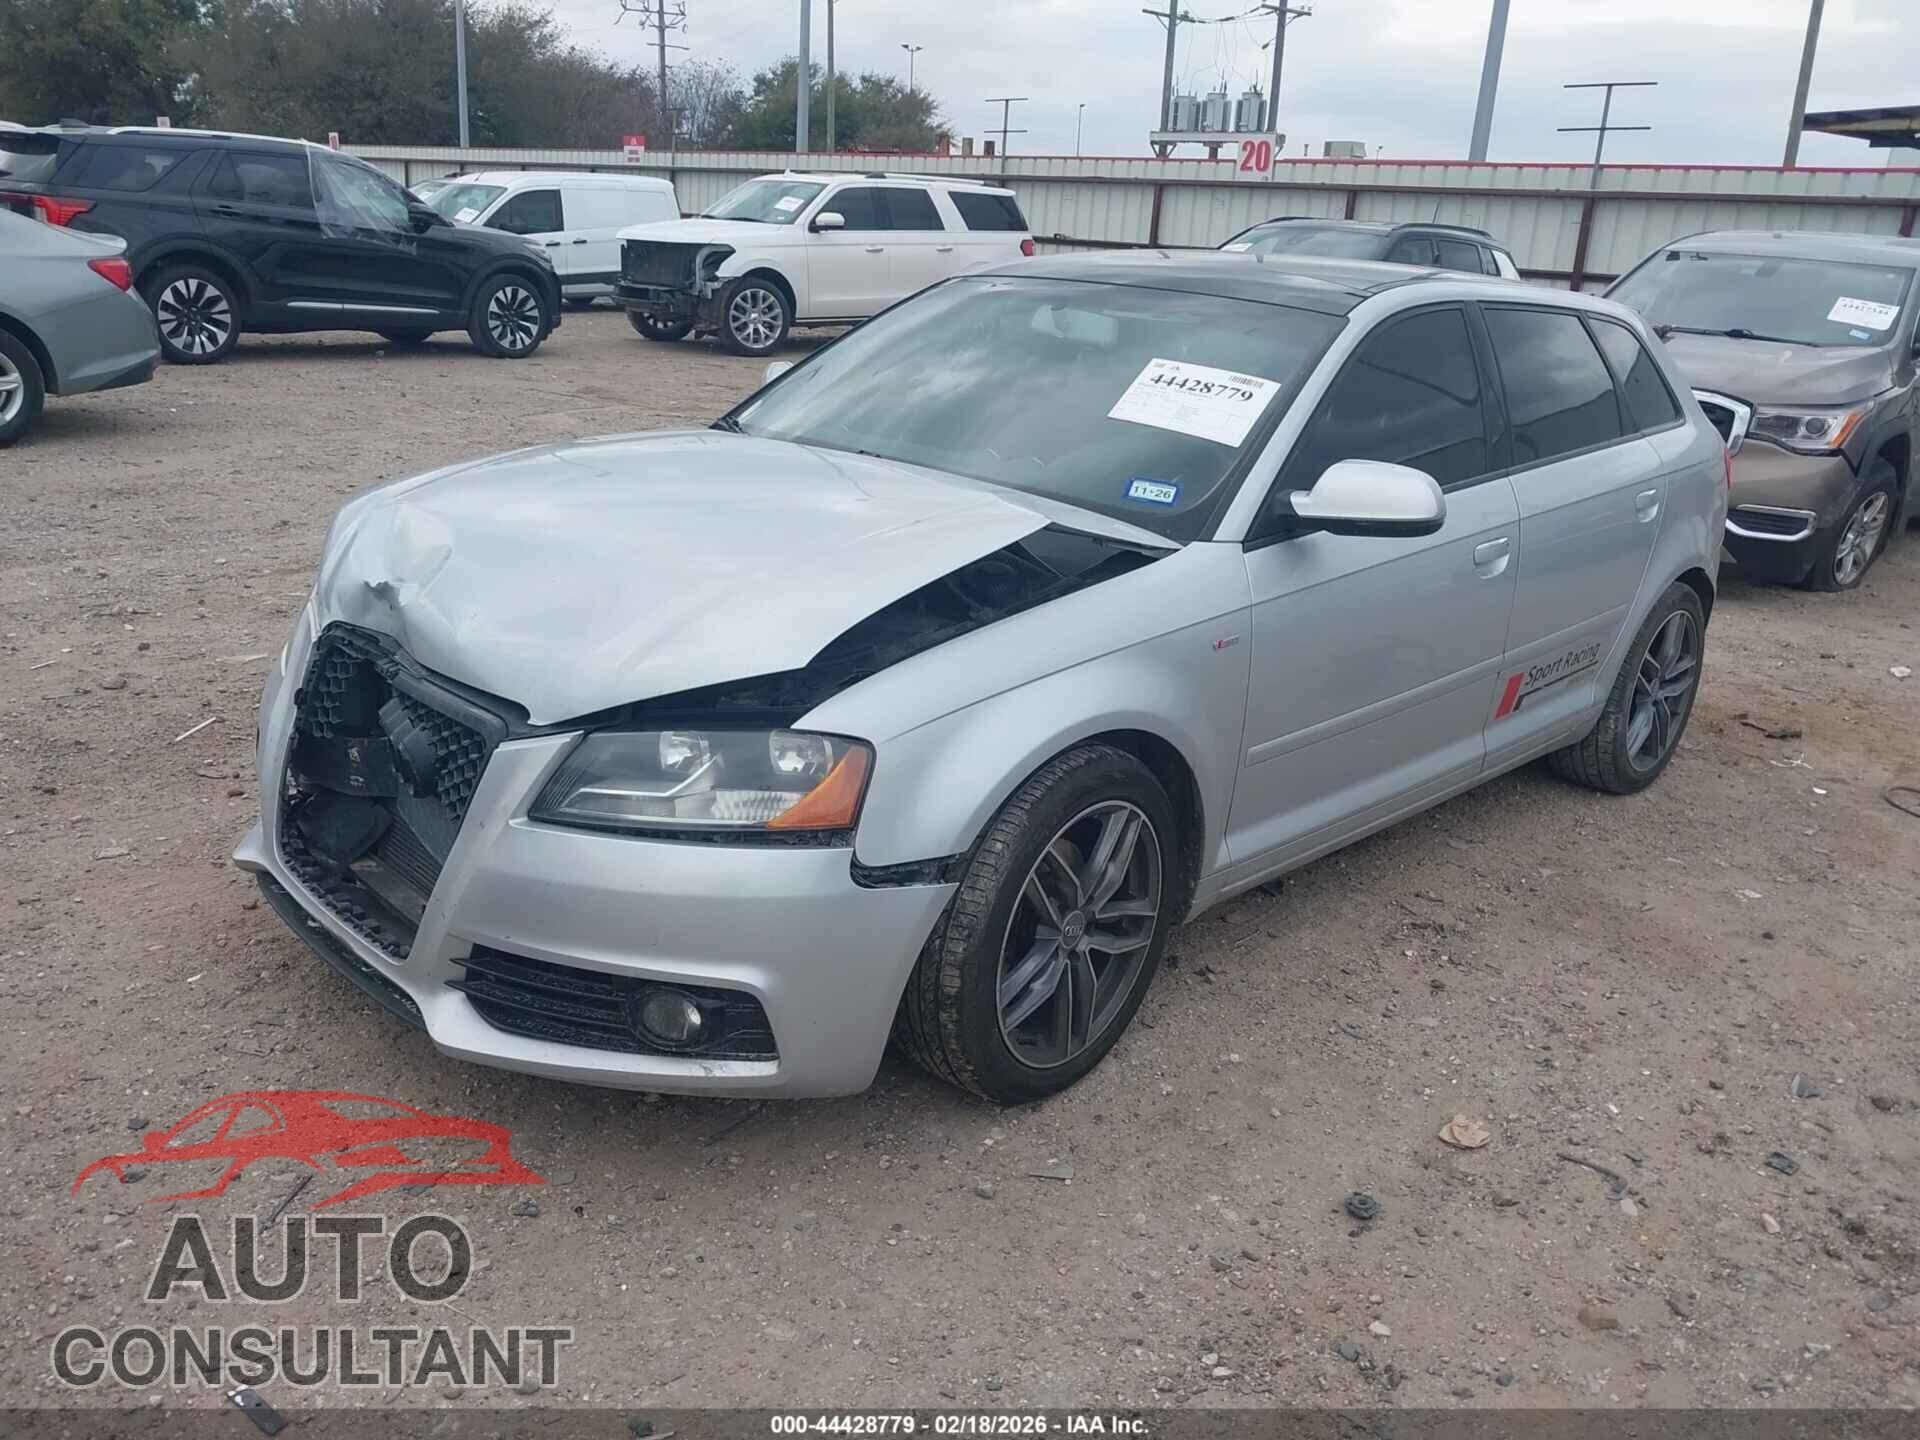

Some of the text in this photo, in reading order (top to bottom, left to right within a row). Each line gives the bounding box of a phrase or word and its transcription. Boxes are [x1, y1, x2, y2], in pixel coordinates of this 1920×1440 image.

[1240, 140, 1270, 172] 20
[1150, 374, 1254, 401] 44428779
[1525, 642, 1600, 688] Sport Racing
